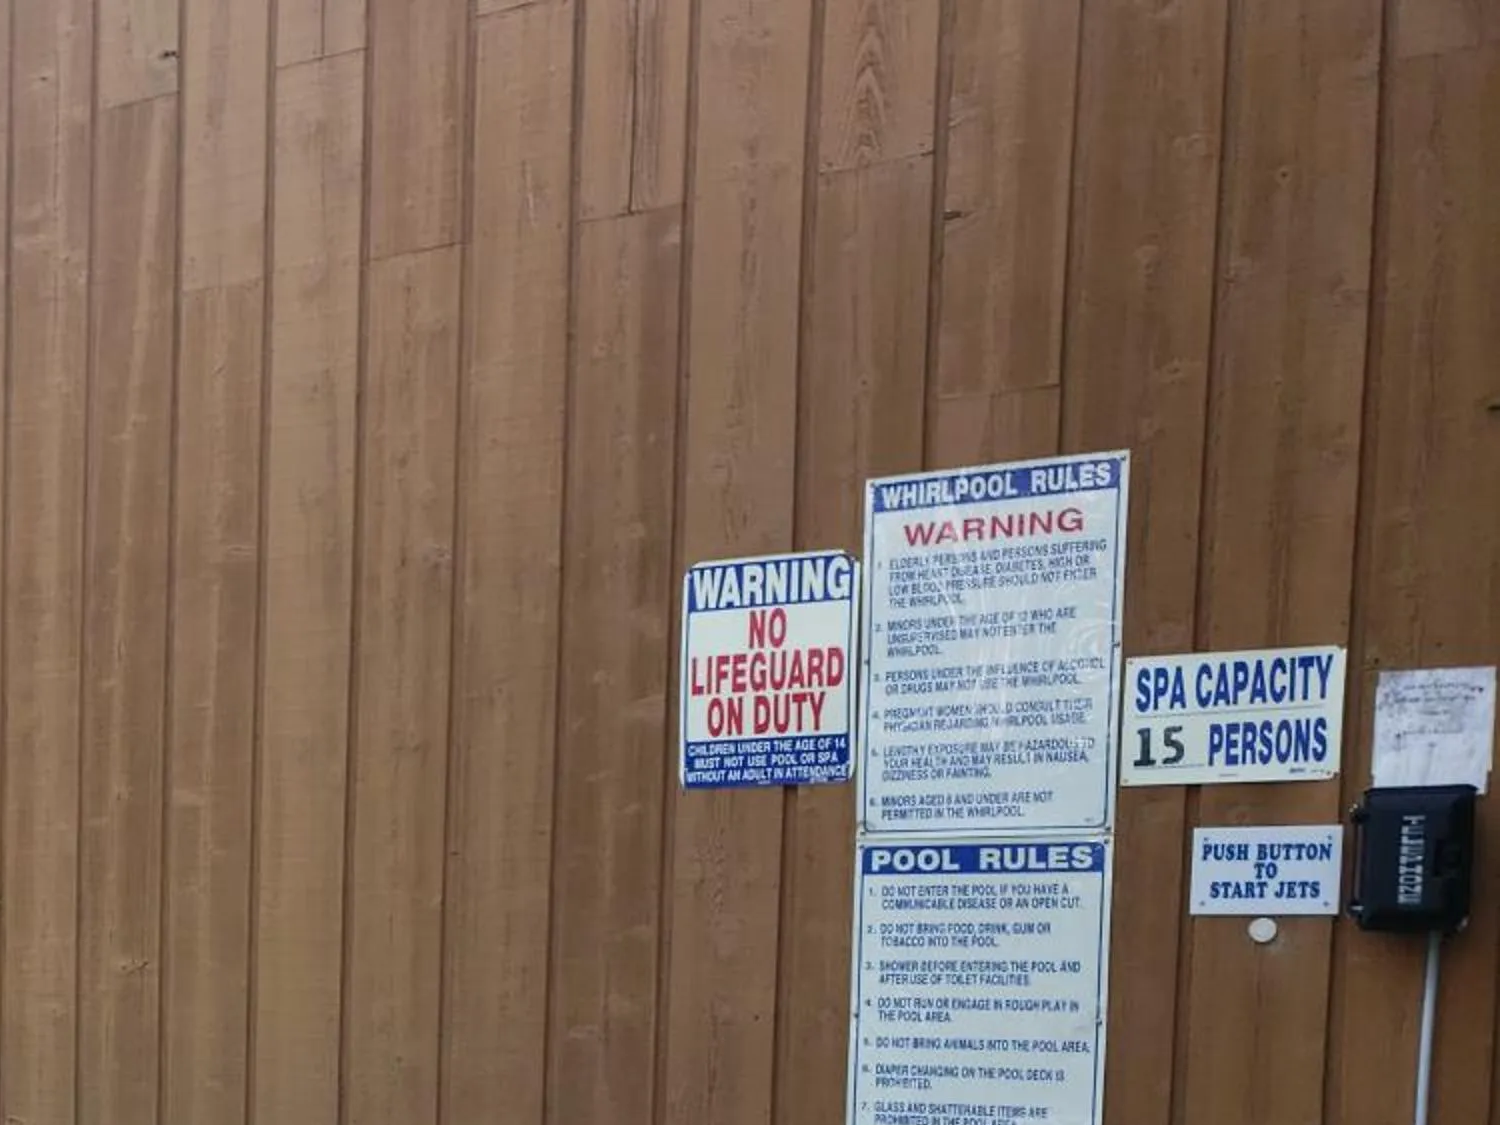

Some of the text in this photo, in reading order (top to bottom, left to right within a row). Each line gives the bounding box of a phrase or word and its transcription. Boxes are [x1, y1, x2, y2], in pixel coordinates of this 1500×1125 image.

[881, 462, 1111, 510] WHIRLPOOL RULES
[903, 507, 1084, 547] WARNING
[693, 556, 851, 610] WARNING
[749, 608, 787, 649] NO
[691, 646, 845, 696] LIFEGUARD
[1135, 653, 1334, 714] SPA CAPACITY
[707, 691, 825, 738] ON DUTY
[688, 736, 846, 756] CHILDREN UNDER THE AGE OF 14
[1133, 717, 1328, 768] 15 PERSONS
[695, 750, 838, 769] MUST NOT USE POOL OR SPA
[686, 764, 846, 782] WITHOUT AN ADULT IN ATTENDANCE
[948, 807, 964, 819] THE
[870, 846, 1093, 872] POOL RULES
[1202, 843, 1333, 862] PUSH BUTTON
[1254, 863, 1277, 880] TO
[882, 883, 1068, 897] DO NOT ENTER THE POOL IF YOU HAVE A
[1210, 881, 1321, 900] START JETS
[958, 898, 996, 909] DISEASE
[1000, 898, 1012, 909] OR
[1015, 898, 1028, 909] AN
[1032, 897, 1058, 909] OPEN
[880, 923, 892, 934] DO
[896, 923, 914, 934] NOT
[928, 936, 948, 947] INTO
[952, 936, 968, 947] THE
[1011, 961, 1028, 973] THE
[1060, 961, 1080, 973] AND
[911, 974, 928, 985] USE
[931, 974, 942, 986] OF
[878, 998, 890, 1009] DO
[894, 998, 911, 1009] NOT
[880, 1010, 923, 1022] THE POOL
[876, 1037, 888, 1048] DO
[1012, 1040, 1029, 1052] THE
[1032, 1040, 1058, 1052] POOL
[978, 1067, 995, 1079] THE
[998, 1068, 1024, 1080] POOL
[908, 1102, 926, 1114] AND
